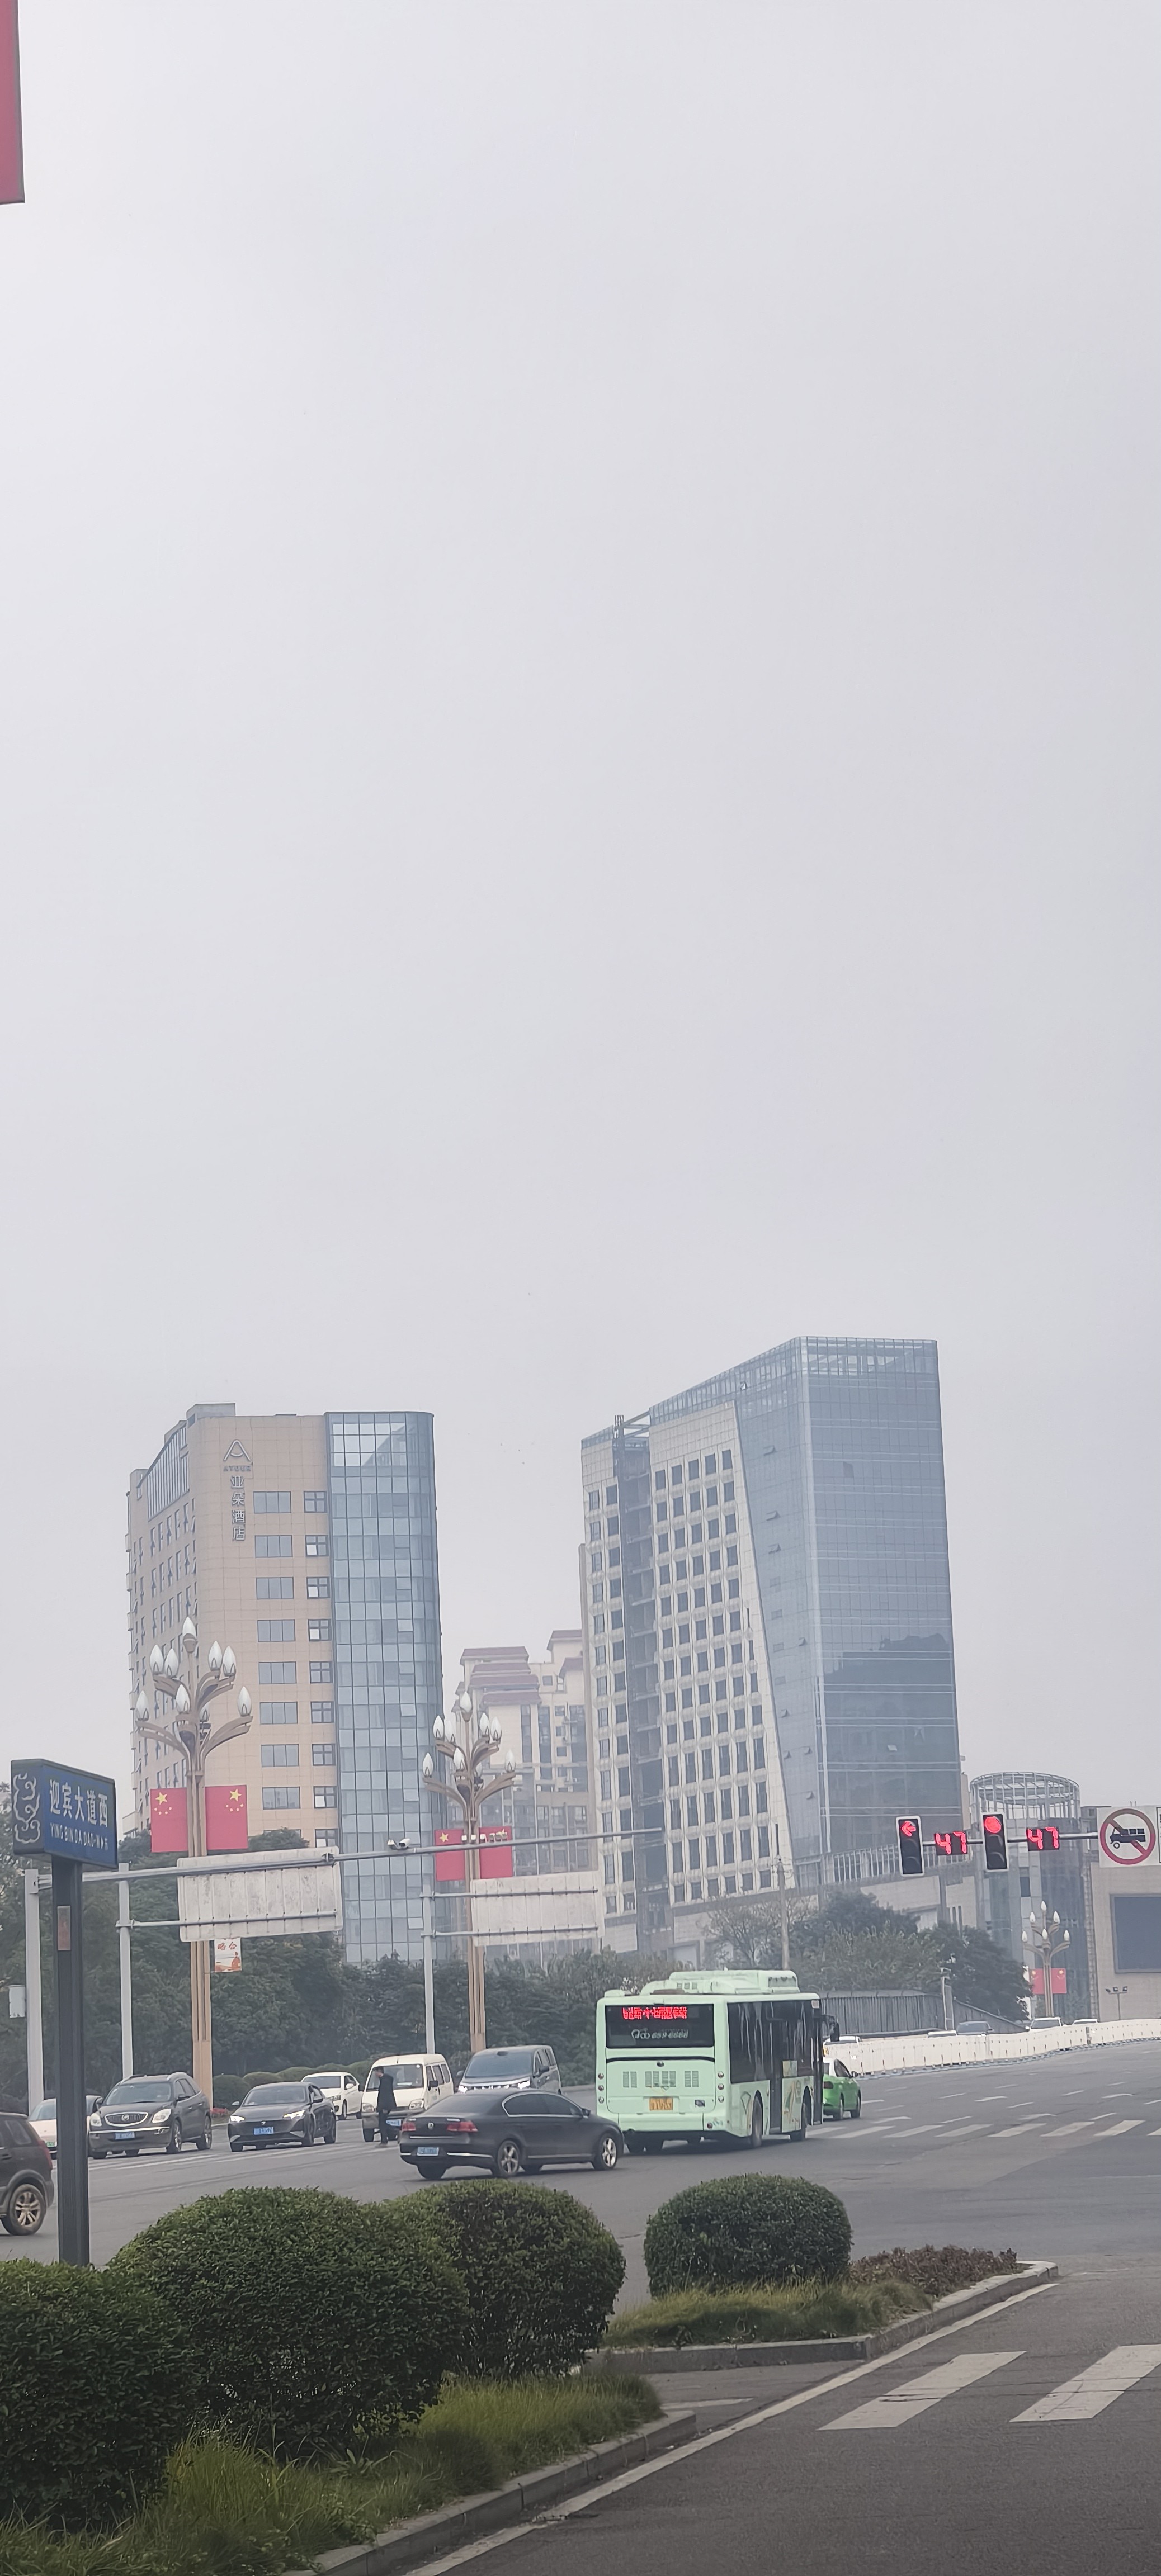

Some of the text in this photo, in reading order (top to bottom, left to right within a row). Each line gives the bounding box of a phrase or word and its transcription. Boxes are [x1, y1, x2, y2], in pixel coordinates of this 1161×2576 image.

[230, 1475, 246, 1541] 亚朵酒店
[49, 1778, 108, 1827] 迎宾大道西
[935, 1831, 967, 1854] 47
[1027, 1826, 1059, 1850] 47
